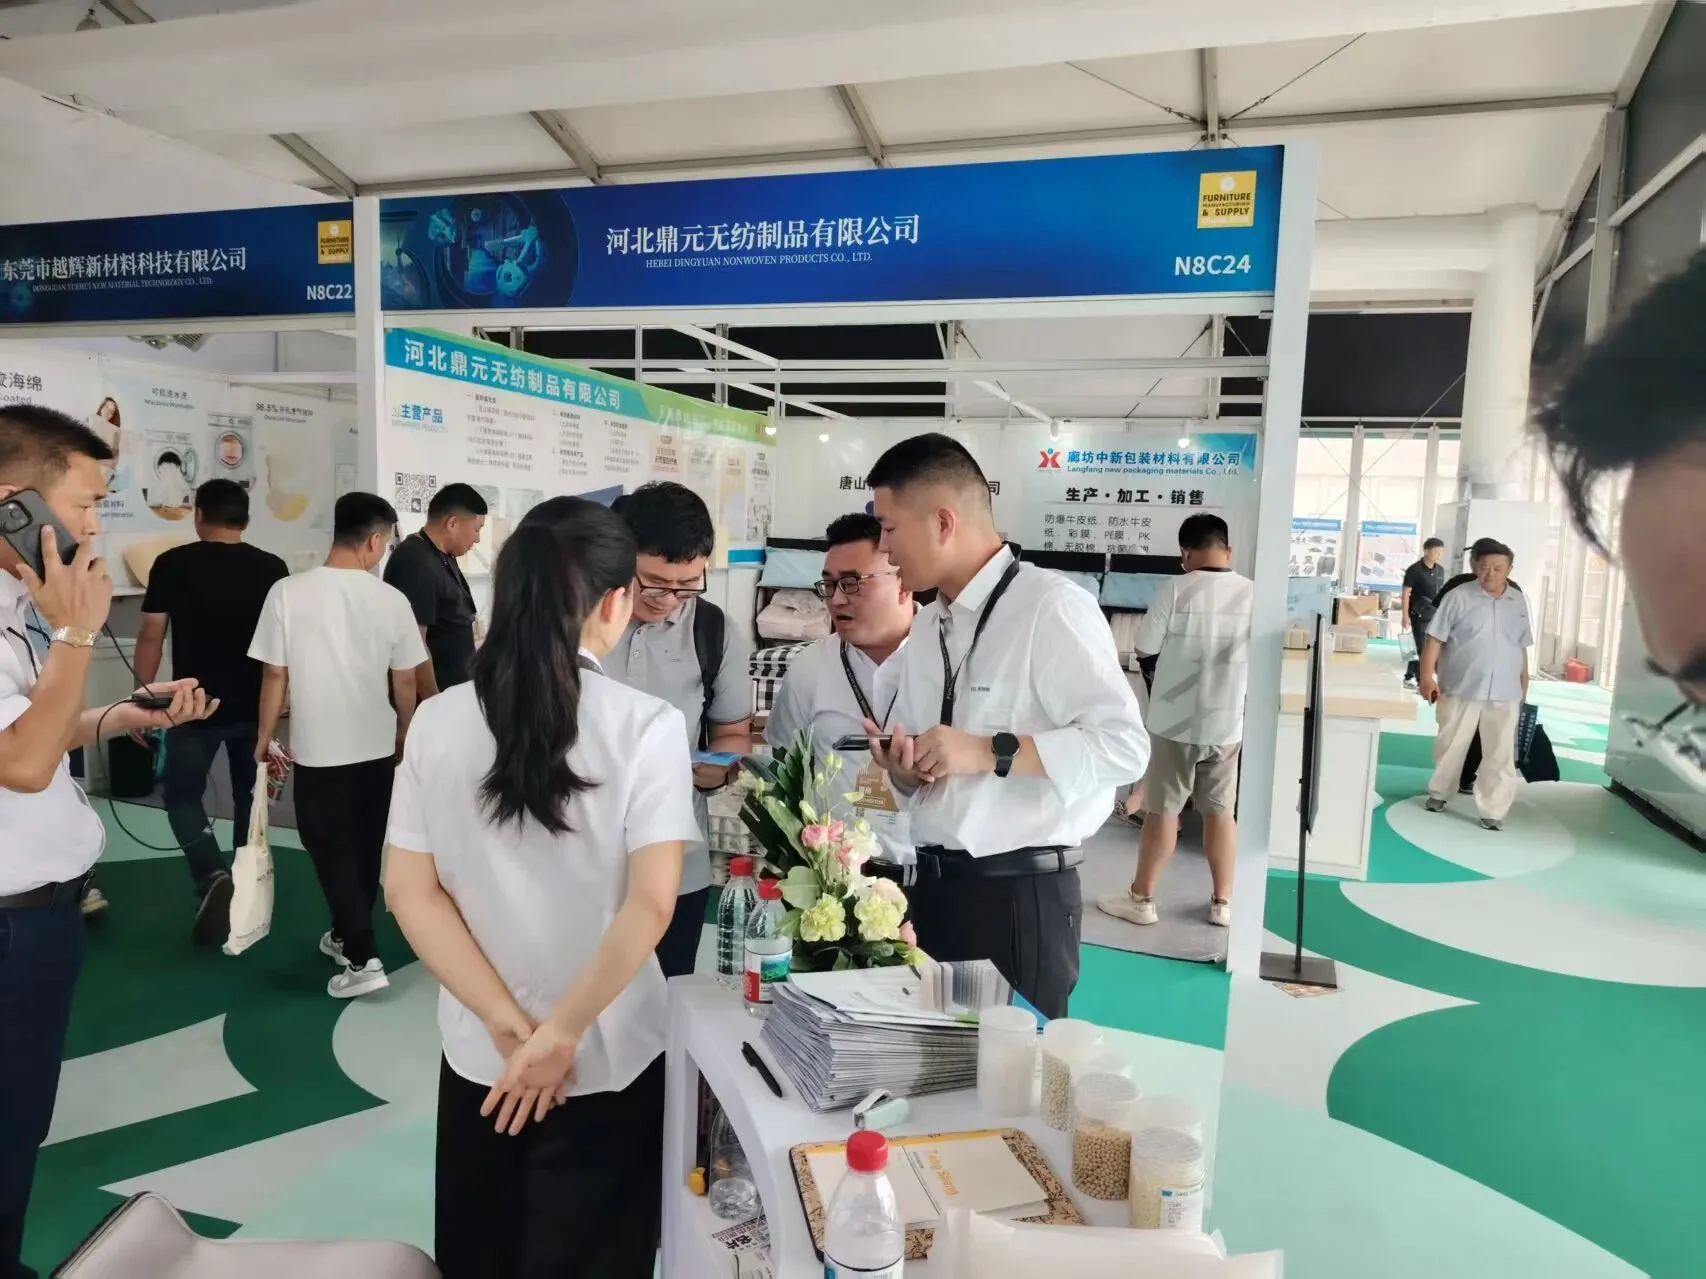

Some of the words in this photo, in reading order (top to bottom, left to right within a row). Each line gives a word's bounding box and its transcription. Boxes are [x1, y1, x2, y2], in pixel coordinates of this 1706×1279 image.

[1203, 192, 1251, 202] FURNITURE
[1202, 209, 1209, 217] &
[1215, 207, 1249, 216] SUPPLY
[606, 214, 920, 255] 河北鼎元无纺制品有限公司
[3, 246, 247, 282] 东莞市越辉新材料科技有限公司
[646, 259, 672, 268] HEBEI
[674, 257, 721, 267] DINGYUAN
[722, 255, 777, 265] NONWOVEN
[779, 253, 829, 264] PRODUCTS
[852, 252, 873, 261] LTD.
[1174, 254, 1251, 276] N8C24
[306, 284, 353, 300] N8C22
[404, 338, 621, 411] 河北鼎元无纺制品有限公司
[400, 404, 443, 424] 主营产品
[1067, 451, 1240, 466] 廊坊中新包装材料有限公司
[1067, 466, 1103, 474] Langfang
[1123, 467, 1164, 476] packaging
[1166, 467, 1204, 475] materials
